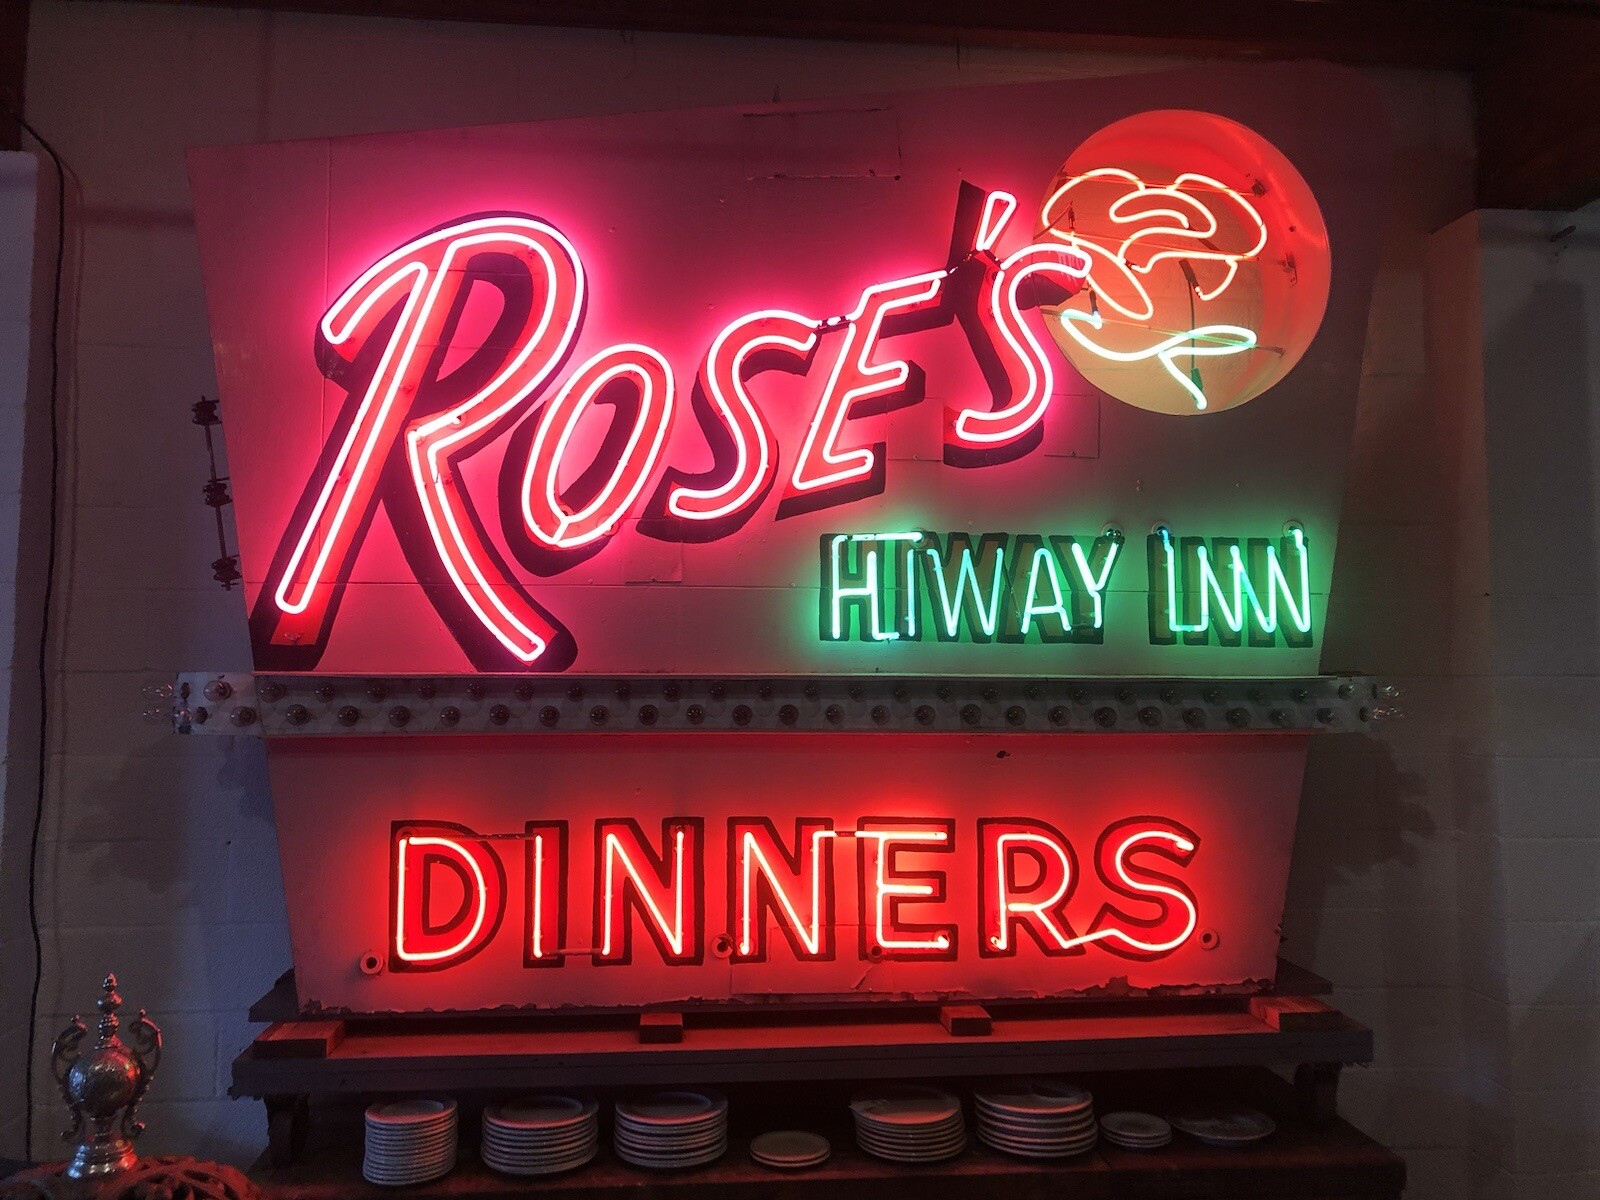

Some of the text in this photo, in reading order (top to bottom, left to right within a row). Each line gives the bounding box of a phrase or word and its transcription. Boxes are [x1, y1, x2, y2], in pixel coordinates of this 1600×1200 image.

[262, 189, 1093, 668] ROSE'S
[820, 530, 1313, 648] HIWAY INN
[389, 816, 1201, 972] DINNERS
